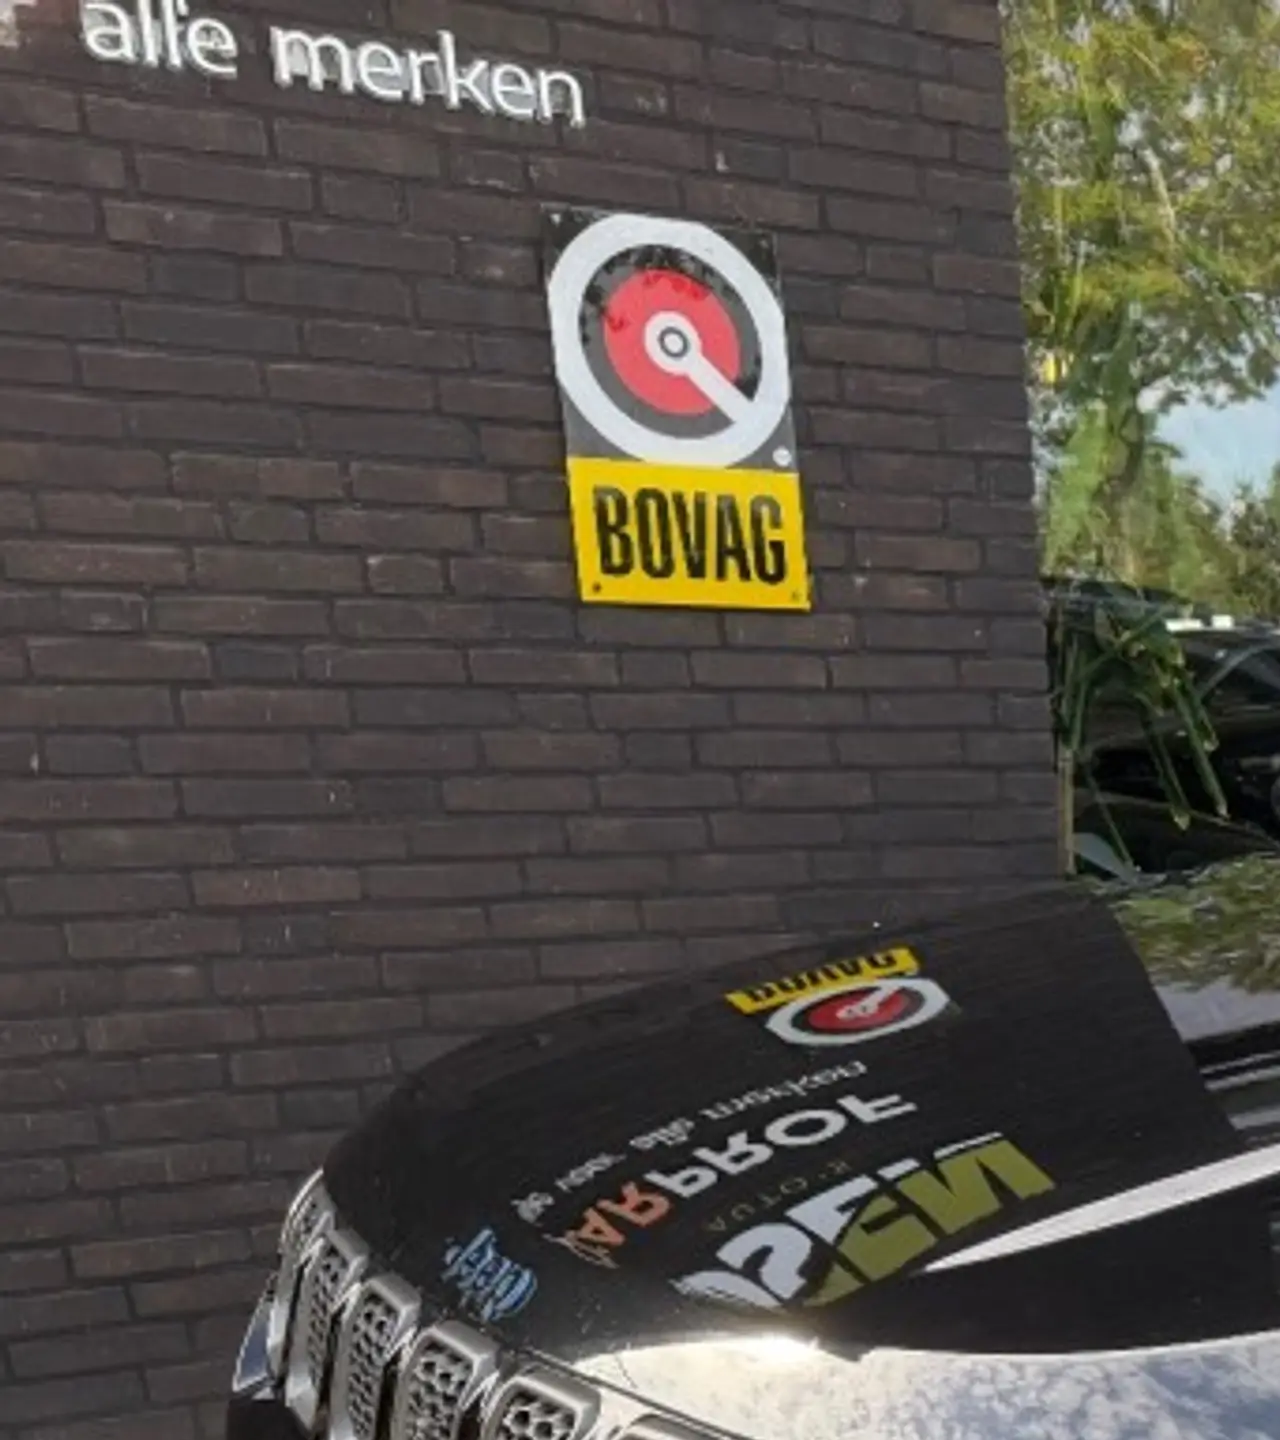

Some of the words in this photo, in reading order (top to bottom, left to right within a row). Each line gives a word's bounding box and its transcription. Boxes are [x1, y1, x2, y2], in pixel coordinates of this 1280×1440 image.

[80, 0, 238, 79] alle
[270, 28, 586, 128] merken
[592, 483, 788, 587] BOVAG
